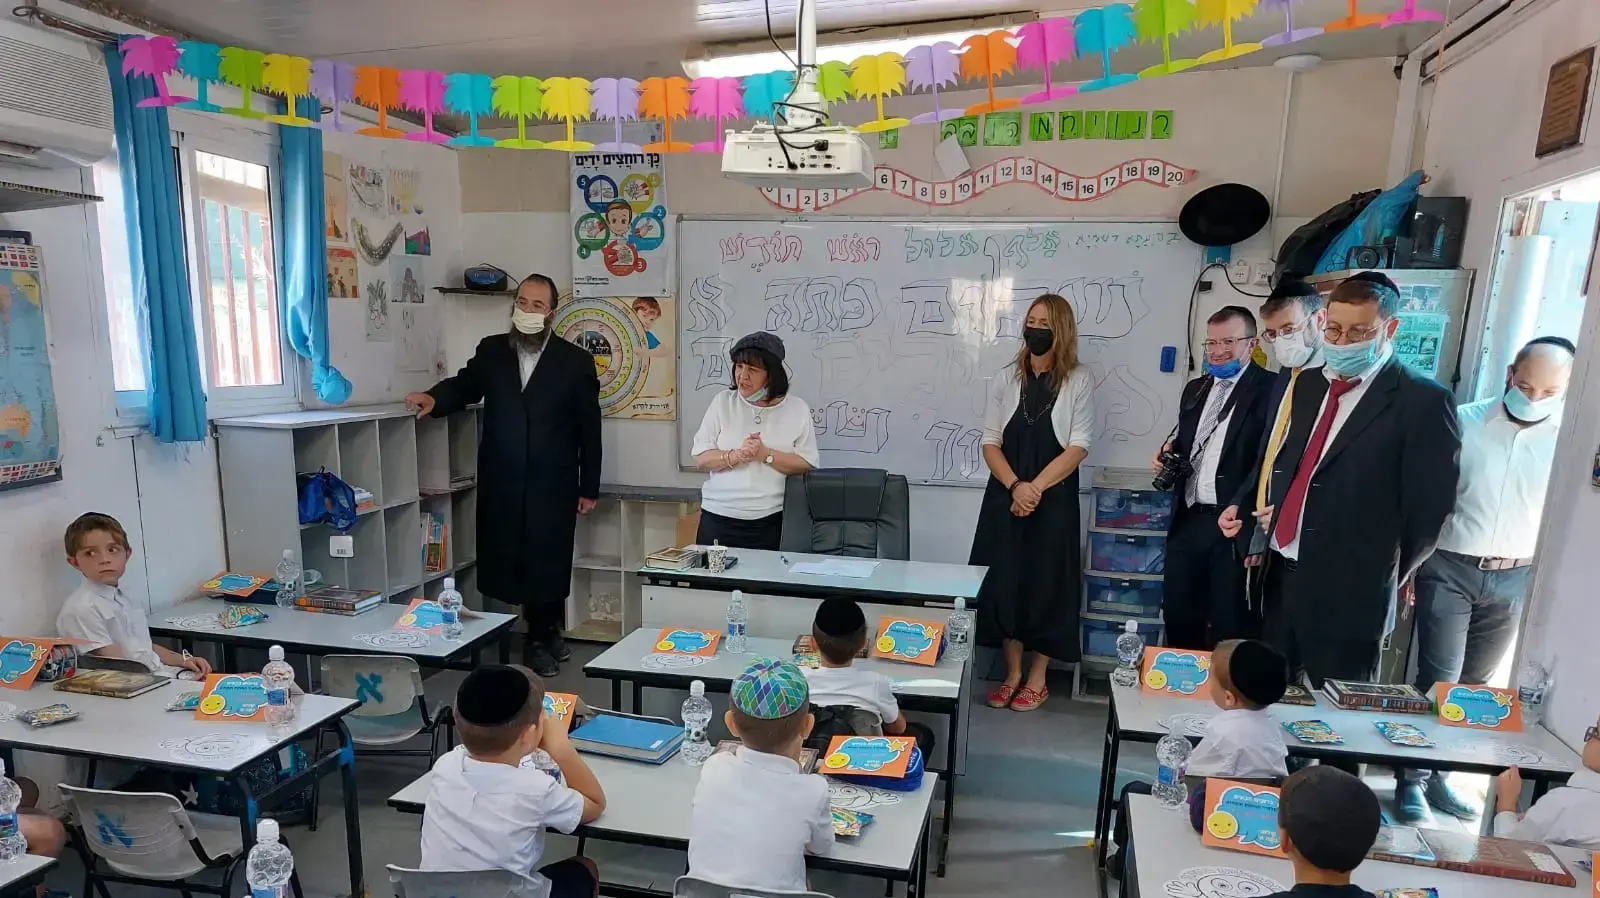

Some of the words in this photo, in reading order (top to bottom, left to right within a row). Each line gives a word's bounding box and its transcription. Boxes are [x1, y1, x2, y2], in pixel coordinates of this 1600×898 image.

[880, 173, 888, 185] 6
[900, 180, 908, 190] 7
[920, 186, 928, 196] 8
[939, 189, 946, 199] 9
[958, 183, 970, 193] 10
[979, 174, 990, 184] 11
[1000, 166, 1013, 176] 12
[1020, 165, 1033, 175] 13
[1040, 173, 1053, 184] 14
[1061, 181, 1074, 191] 15
[1082, 184, 1094, 194] 16
[1104, 176, 1116, 187] 17
[1126, 166, 1138, 177] 18
[1147, 165, 1159, 175] 19
[1167, 171, 1183, 182] 20
[355, 671, 384, 704] א
